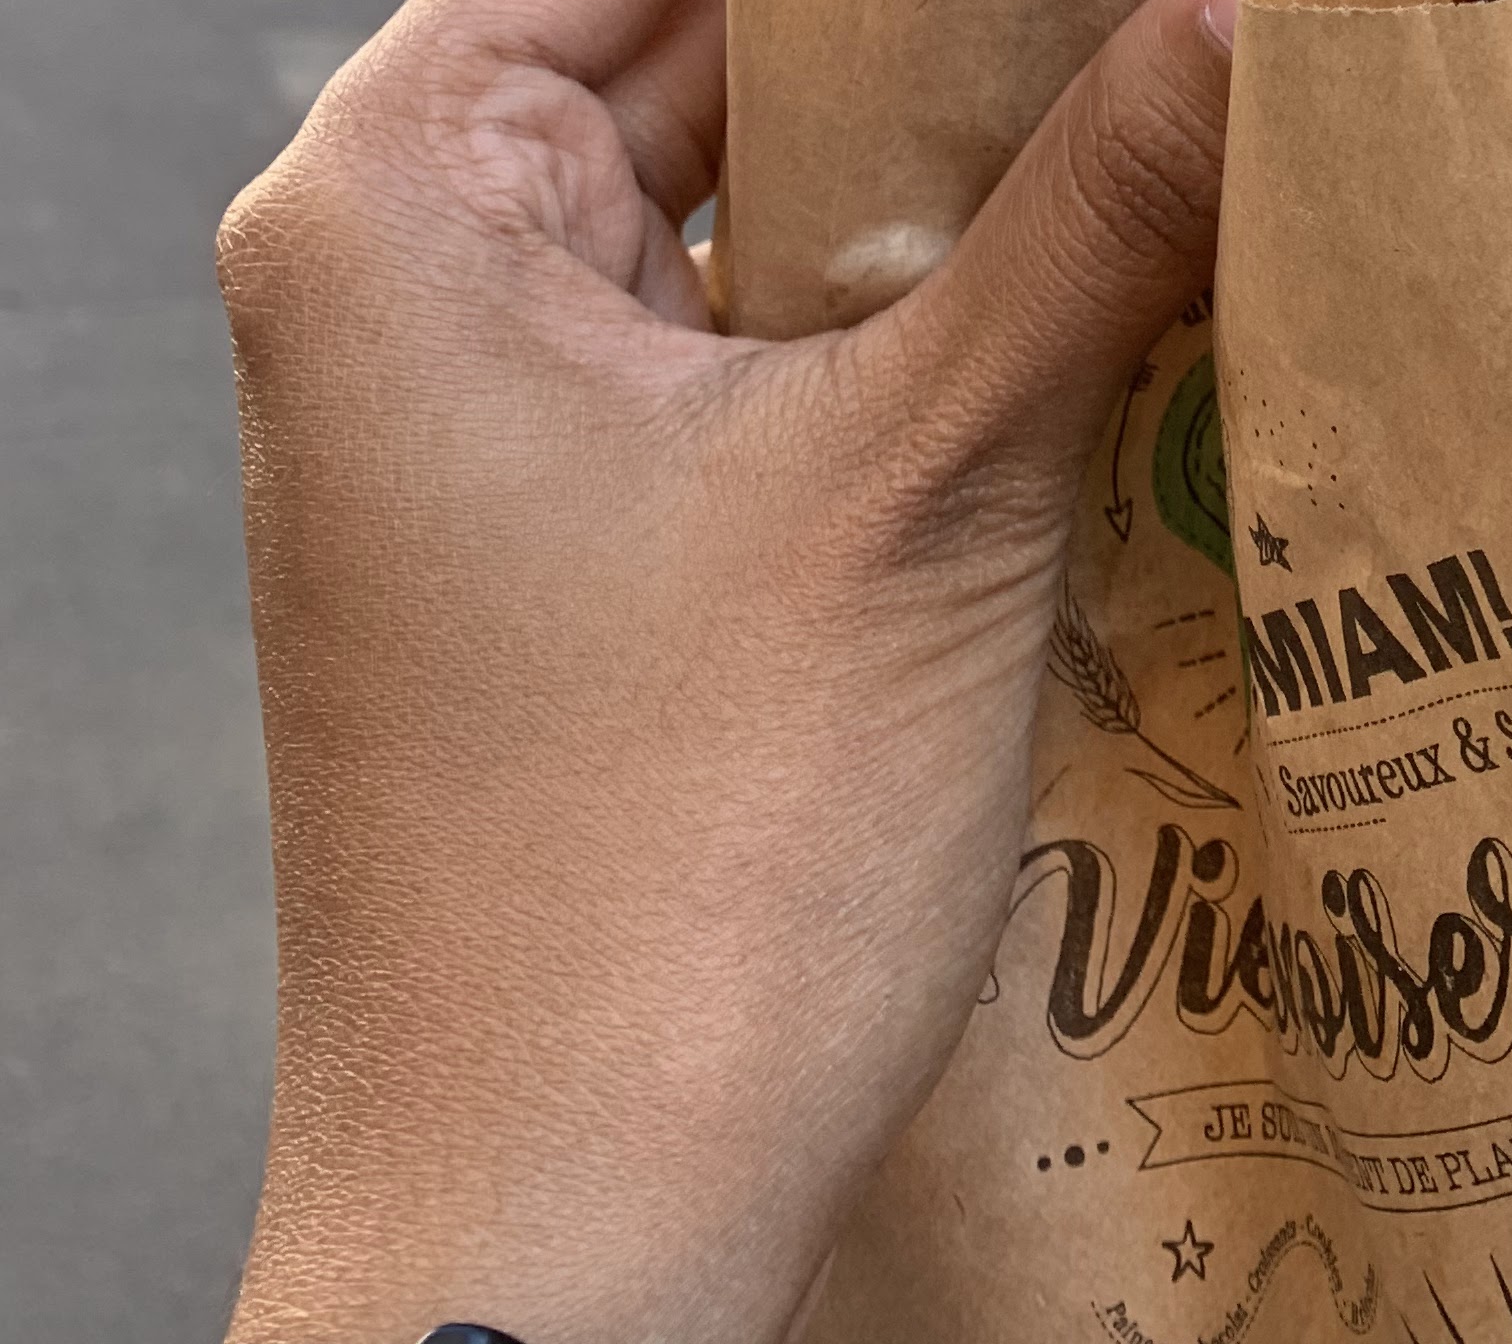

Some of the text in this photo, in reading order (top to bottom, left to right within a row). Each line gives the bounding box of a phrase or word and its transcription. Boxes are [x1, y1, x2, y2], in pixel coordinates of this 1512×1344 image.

[1278, 742, 1456, 817] Savoureux
[1451, 716, 1501, 774] &
[1203, 1103, 1252, 1143] JE
[1386, 1154, 1439, 1196] DE
